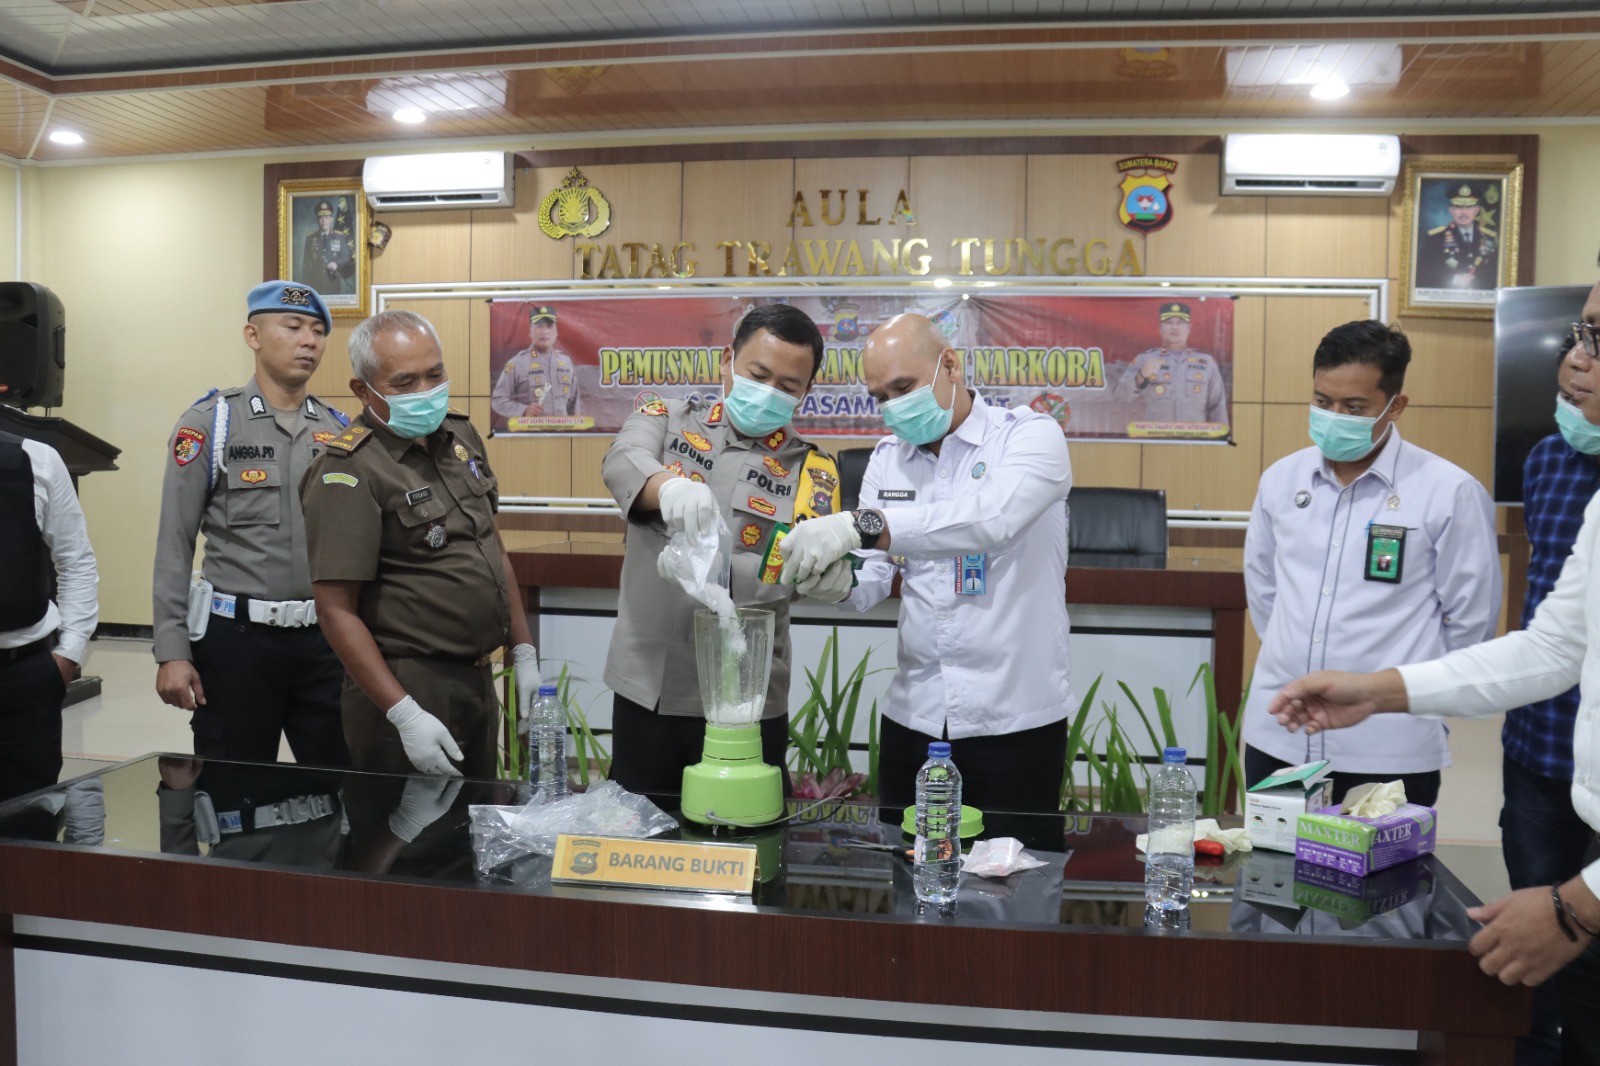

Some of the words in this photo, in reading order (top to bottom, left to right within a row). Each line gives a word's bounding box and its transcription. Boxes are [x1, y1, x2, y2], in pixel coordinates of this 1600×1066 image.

[1119, 158, 1153, 170] SUMATERA
[1154, 158, 1177, 170] BARAT
[786, 188, 917, 227] AULA
[575, 242, 696, 279] TATAG
[716, 238, 932, 277] TRAWANG
[952, 238, 1145, 276] TUNGGA
[973, 347, 1106, 388] NARKOBA
[180, 428, 204, 440] PROPAM
[669, 437, 714, 471] AGUNG
[746, 469, 792, 497] POLRI
[1299, 821, 1362, 847] MAXTER
[608, 852, 685, 872] BARANG
[690, 856, 745, 876] BUKTI
